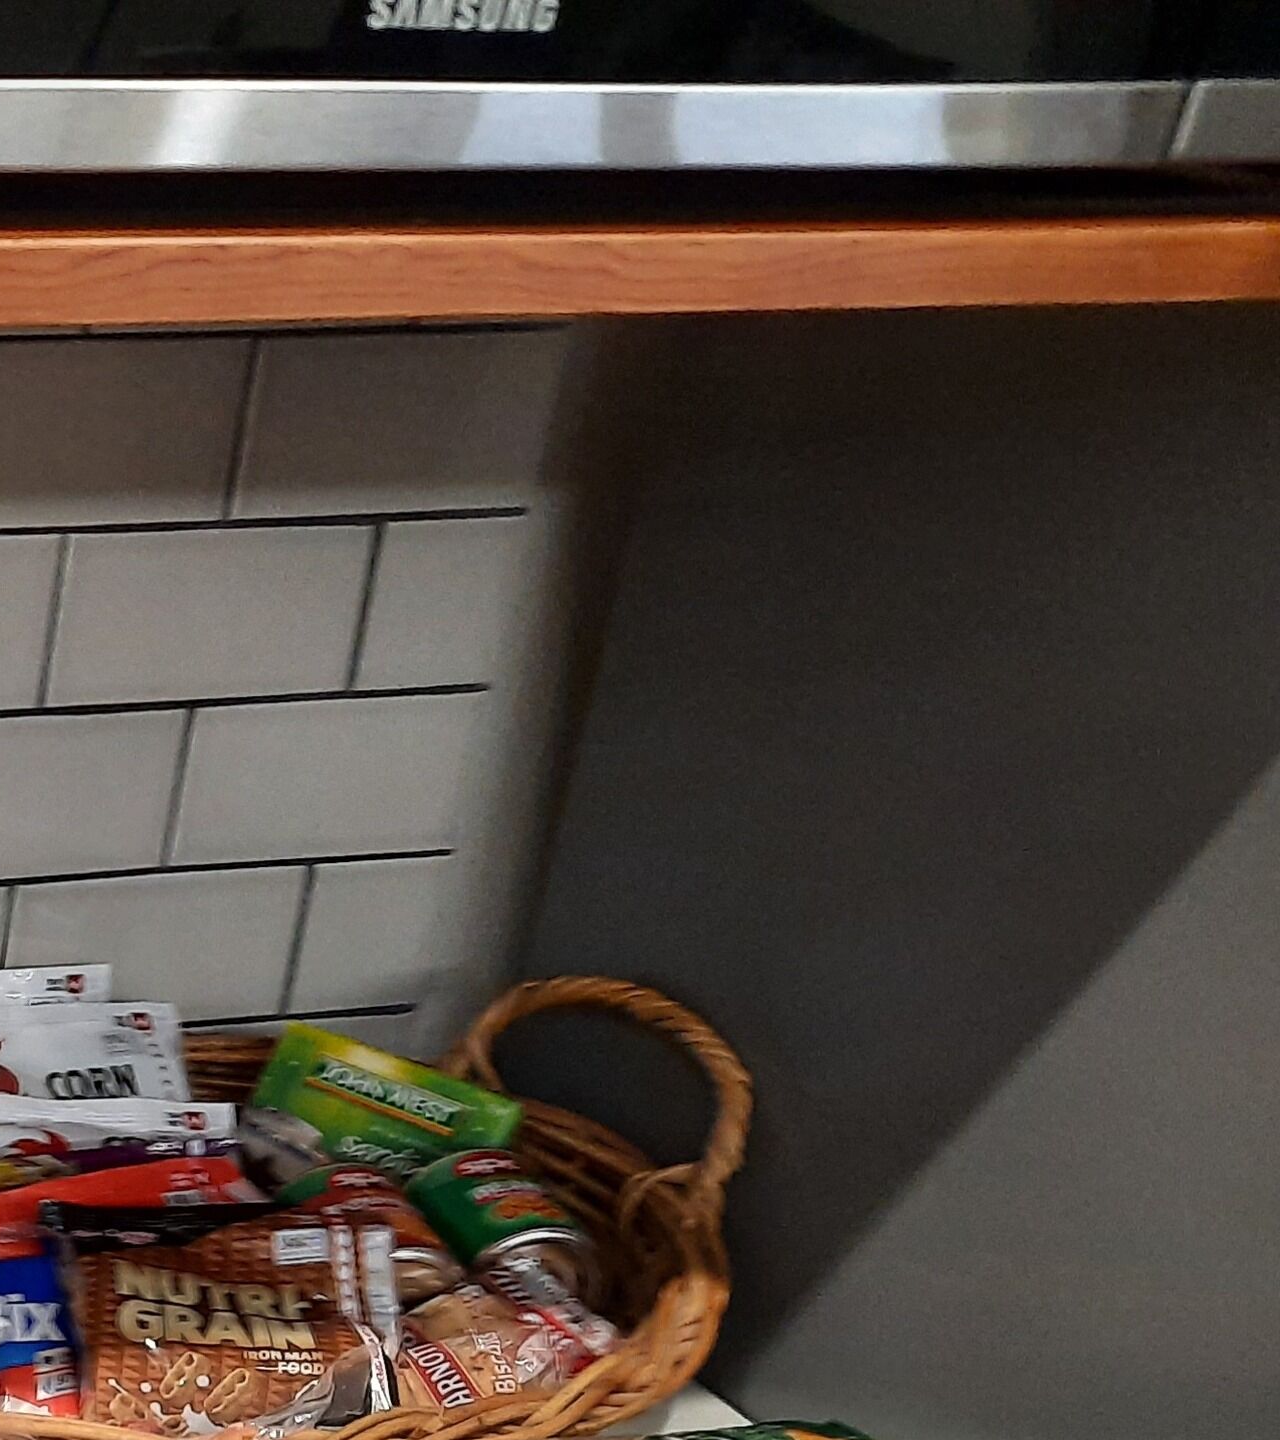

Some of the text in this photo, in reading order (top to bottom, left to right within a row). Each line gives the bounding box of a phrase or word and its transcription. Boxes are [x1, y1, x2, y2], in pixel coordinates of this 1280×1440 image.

[118, 1300, 317, 1349] GRAIN
[284, 1350, 324, 1361] MAN
[277, 1362, 325, 1375] FOOD
